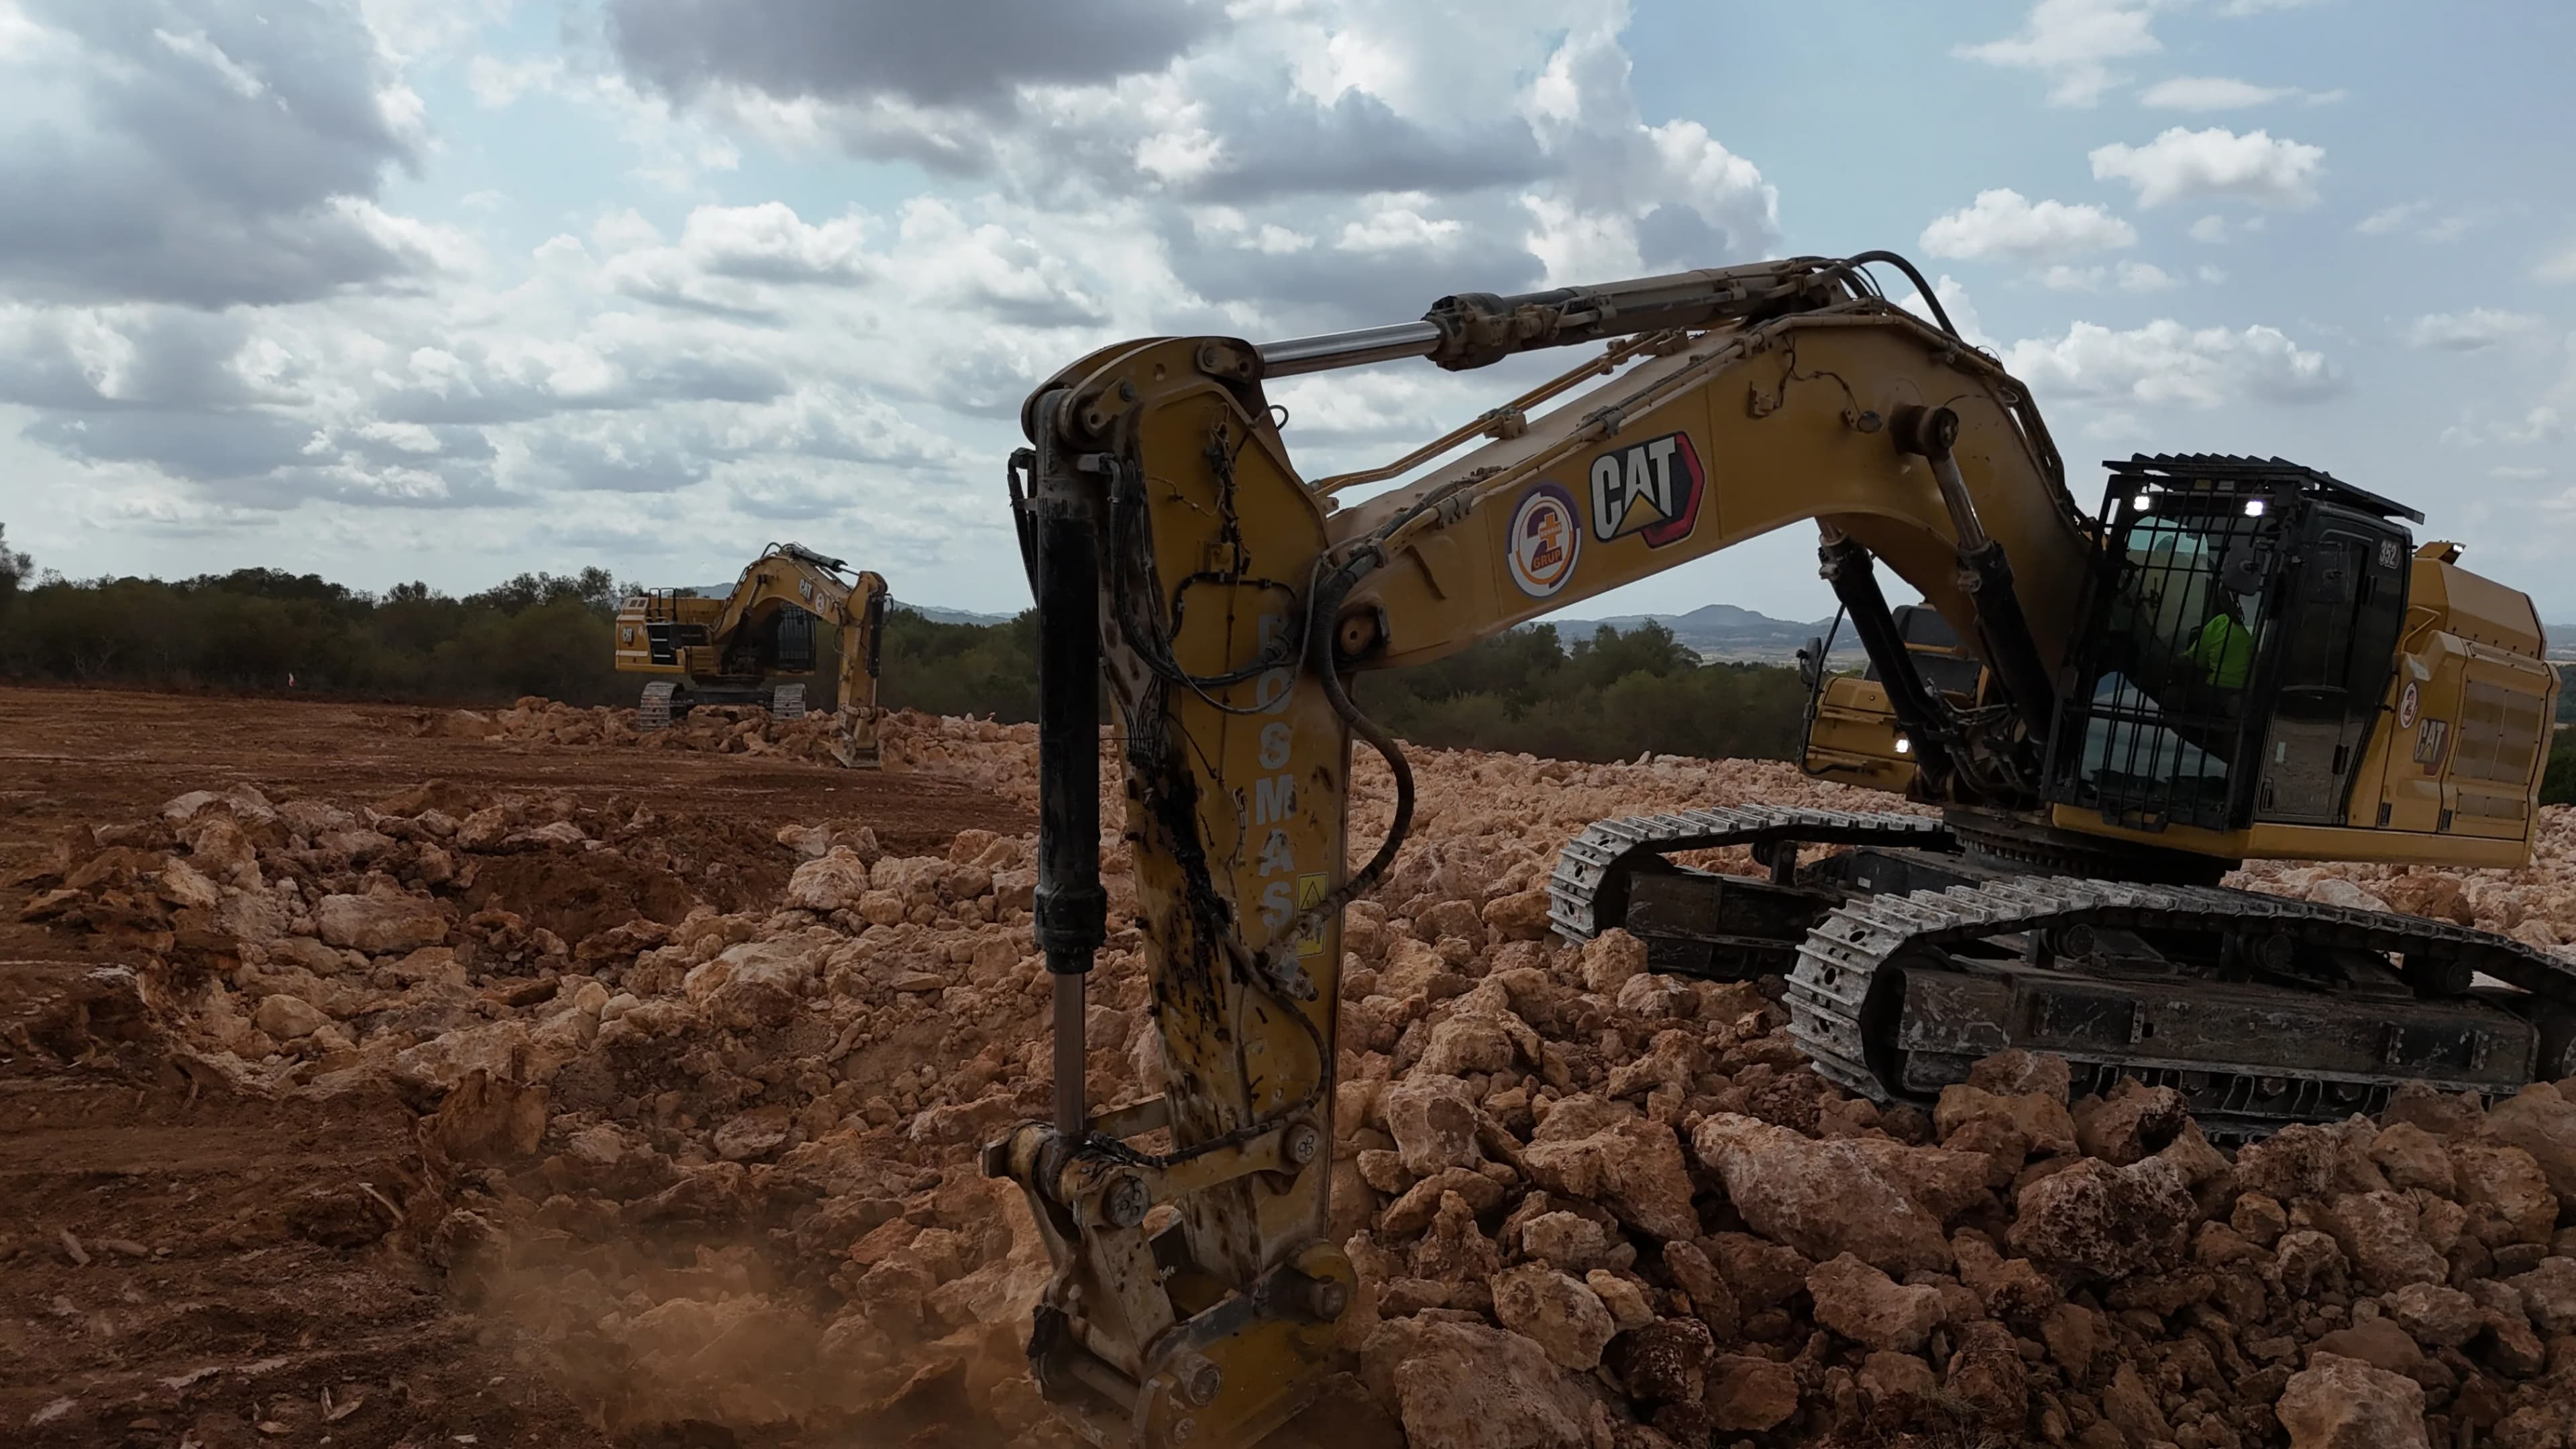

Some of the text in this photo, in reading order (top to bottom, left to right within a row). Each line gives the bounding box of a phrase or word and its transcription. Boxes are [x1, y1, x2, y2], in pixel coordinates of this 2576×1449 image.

[1591, 436, 1676, 540] CAT
[1533, 549, 1562, 569] GRUP
[2379, 539, 2397, 566] 352
[2414, 719, 2446, 761] CAT
